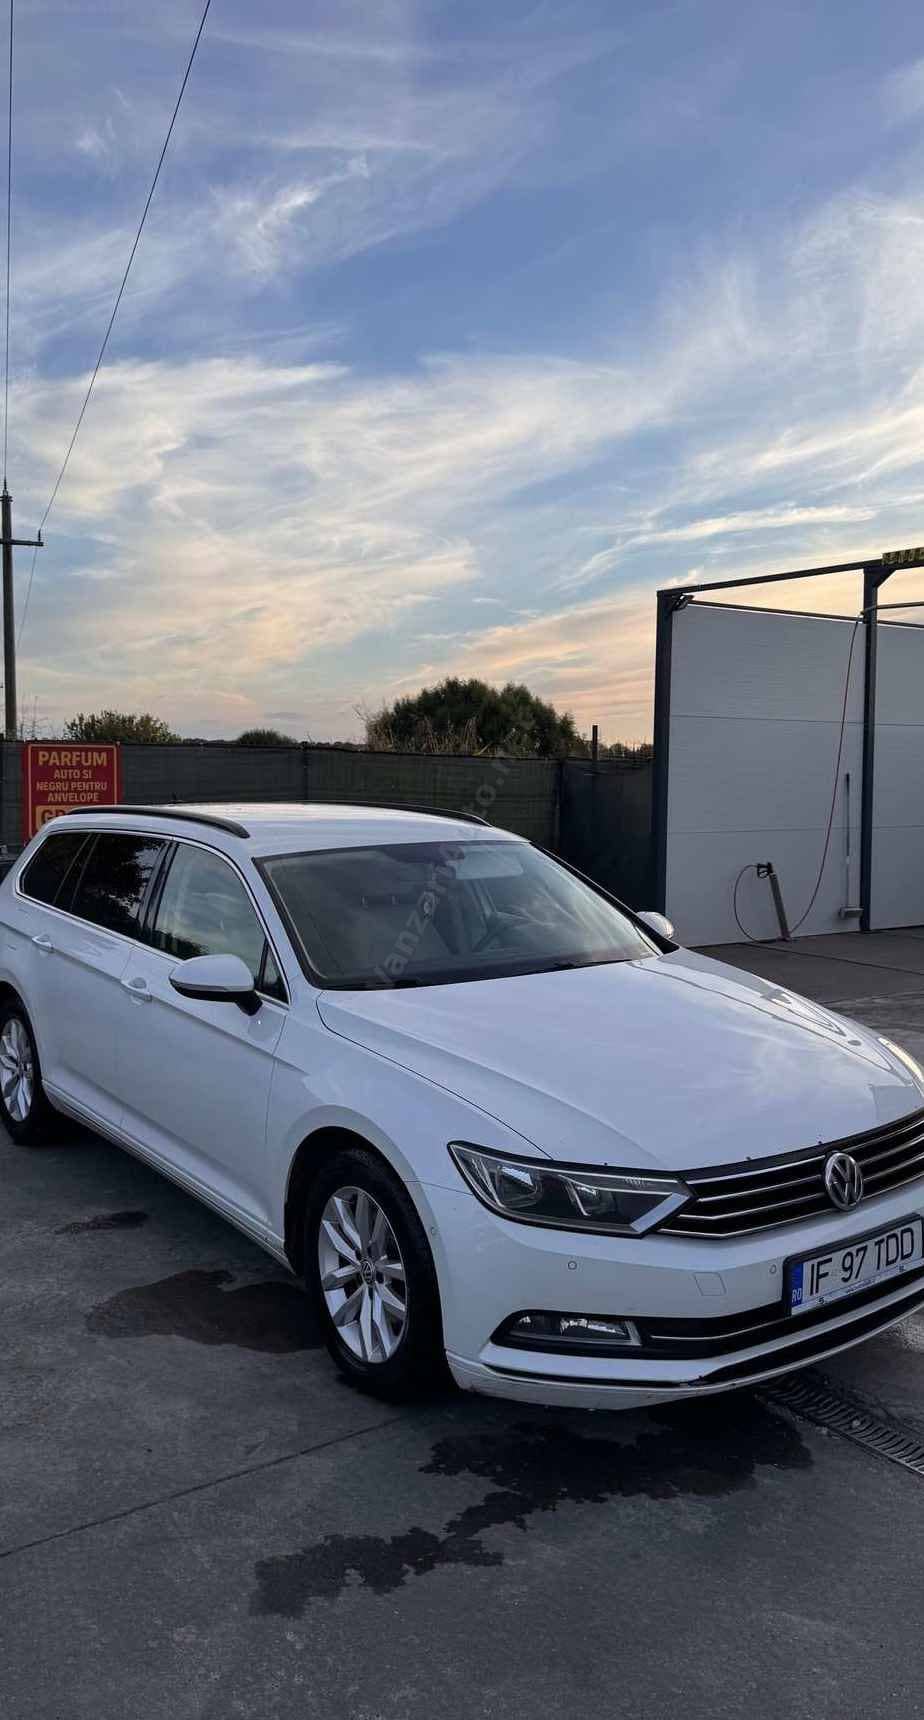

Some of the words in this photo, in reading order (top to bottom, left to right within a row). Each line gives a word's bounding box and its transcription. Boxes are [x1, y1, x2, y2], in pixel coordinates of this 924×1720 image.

[38, 751, 108, 767] PARFUM
[53, 769, 81, 779] AUTO
[82, 769, 93, 779] SI
[36, 781, 69, 791] NEGRU
[70, 781, 108, 791] PENTRU
[47, 792, 101, 802] ANVELOPE
[809, 1257, 833, 1296] IF
[841, 1244, 868, 1283] 97
[874, 1227, 915, 1271] TDD
